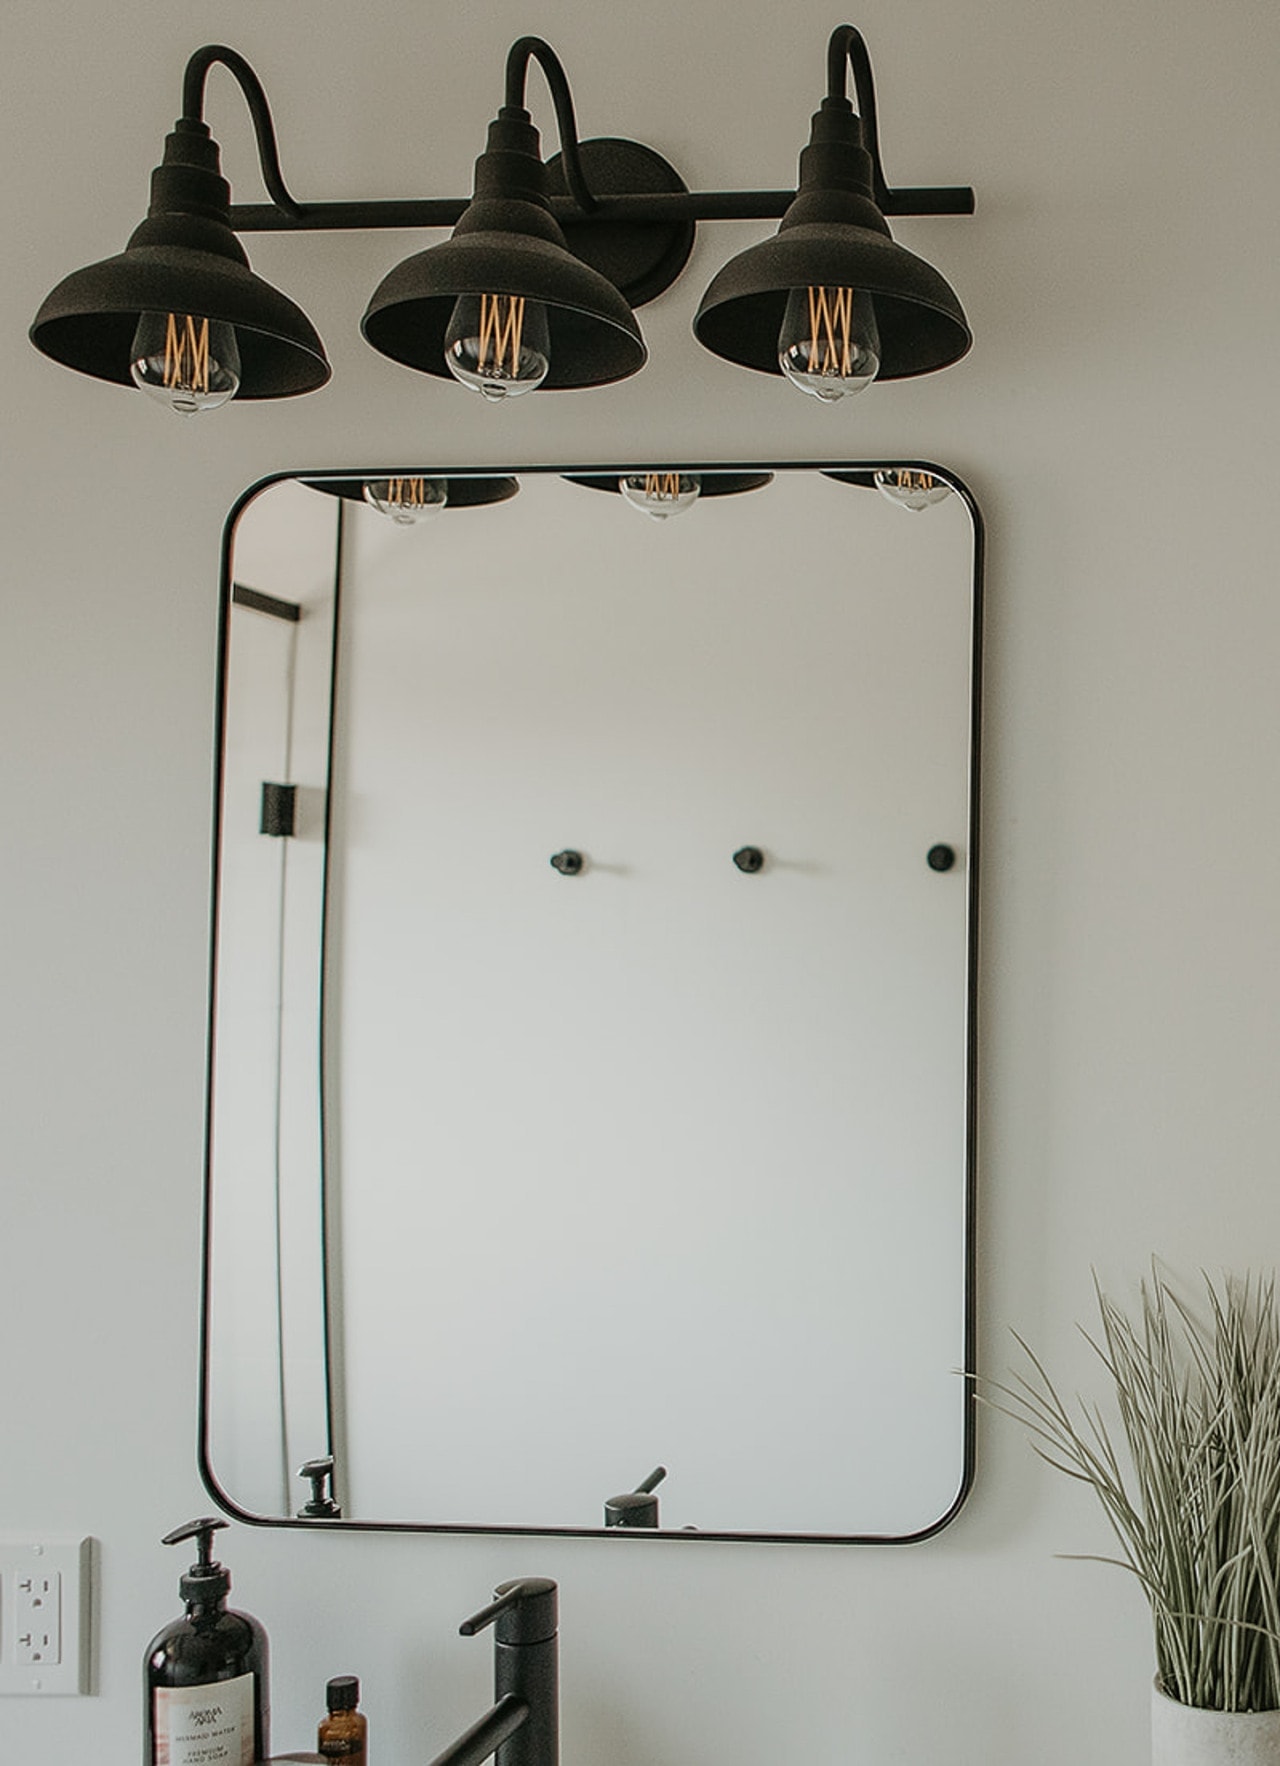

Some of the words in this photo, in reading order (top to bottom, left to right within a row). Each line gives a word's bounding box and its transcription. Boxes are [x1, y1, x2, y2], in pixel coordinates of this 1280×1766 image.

[211, 1726, 235, 1737] WATER
[182, 1756, 206, 1764] HAND
[207, 1750, 229, 1761] SOAP
[187, 1745, 224, 1757] PREMIUM
